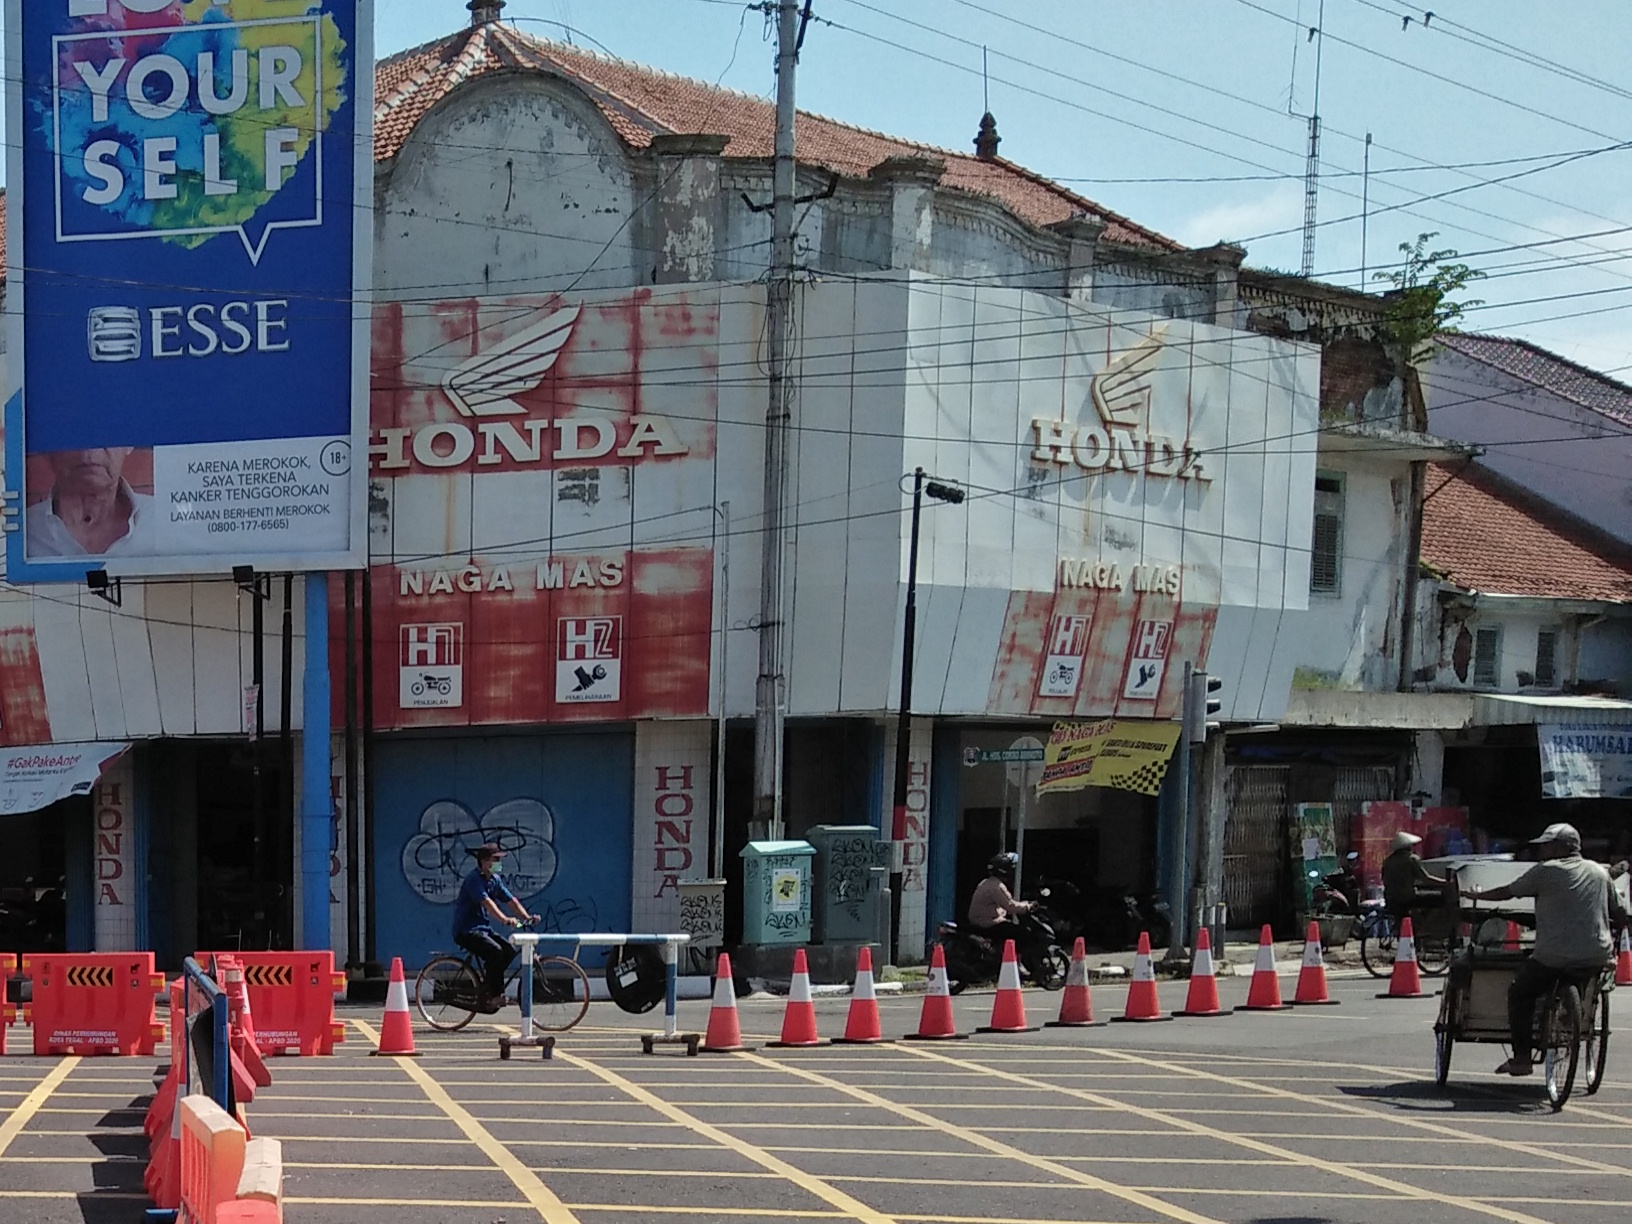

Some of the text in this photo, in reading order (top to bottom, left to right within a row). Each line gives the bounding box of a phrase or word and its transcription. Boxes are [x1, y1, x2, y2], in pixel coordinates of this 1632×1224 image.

[73, 43, 306, 124] YOUR
[81, 127, 299, 206] SELF
[149, 299, 293, 359] ESSE
[188, 456, 311, 475] KARENA MEROKOK,
[369, 415, 689, 470] HONDA
[1031, 419, 1214, 483] HONDA
[170, 484, 330, 504] KANKER TENGGOROKAN
[202, 471, 297, 488] SAYA TERKENA
[170, 504, 331, 522] LAYANAN BERHENTI MEROKOK
[399, 559, 623, 596] NAGA MAS
[1060, 559, 1181, 597] NAGA MAS
[97, 783, 124, 905] HONDA
[654, 765, 694, 898] HONDA
[903, 761, 929, 892] HONDA
